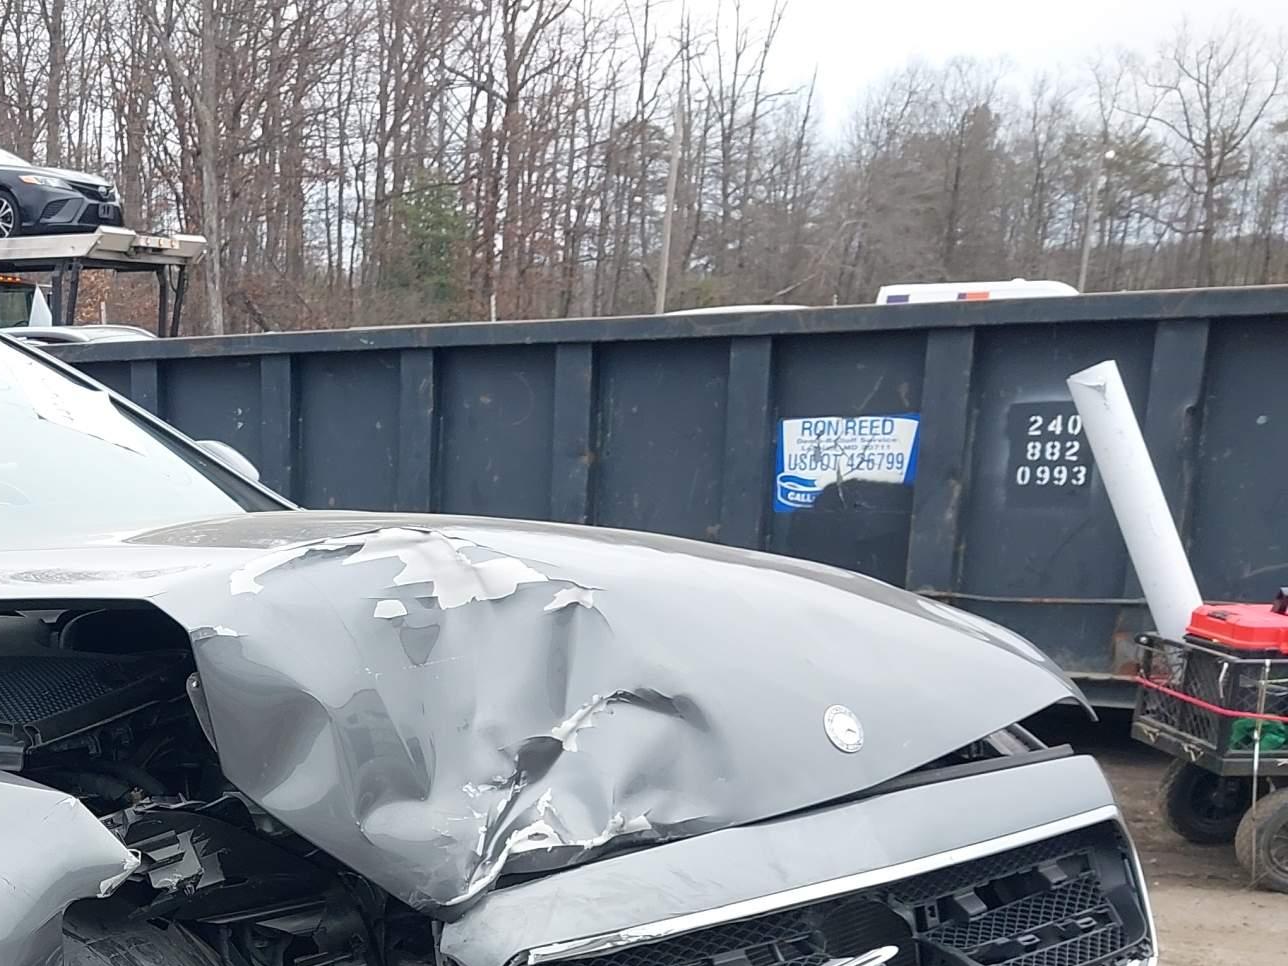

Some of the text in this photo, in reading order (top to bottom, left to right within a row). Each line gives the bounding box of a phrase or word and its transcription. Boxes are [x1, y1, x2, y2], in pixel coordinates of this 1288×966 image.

[801, 419, 894, 436] RON REED
[1028, 415, 1082, 436] 240
[1026, 441, 1080, 461] 882
[788, 452, 905, 471] USDOT 426799
[1016, 466, 1087, 486] 0993
